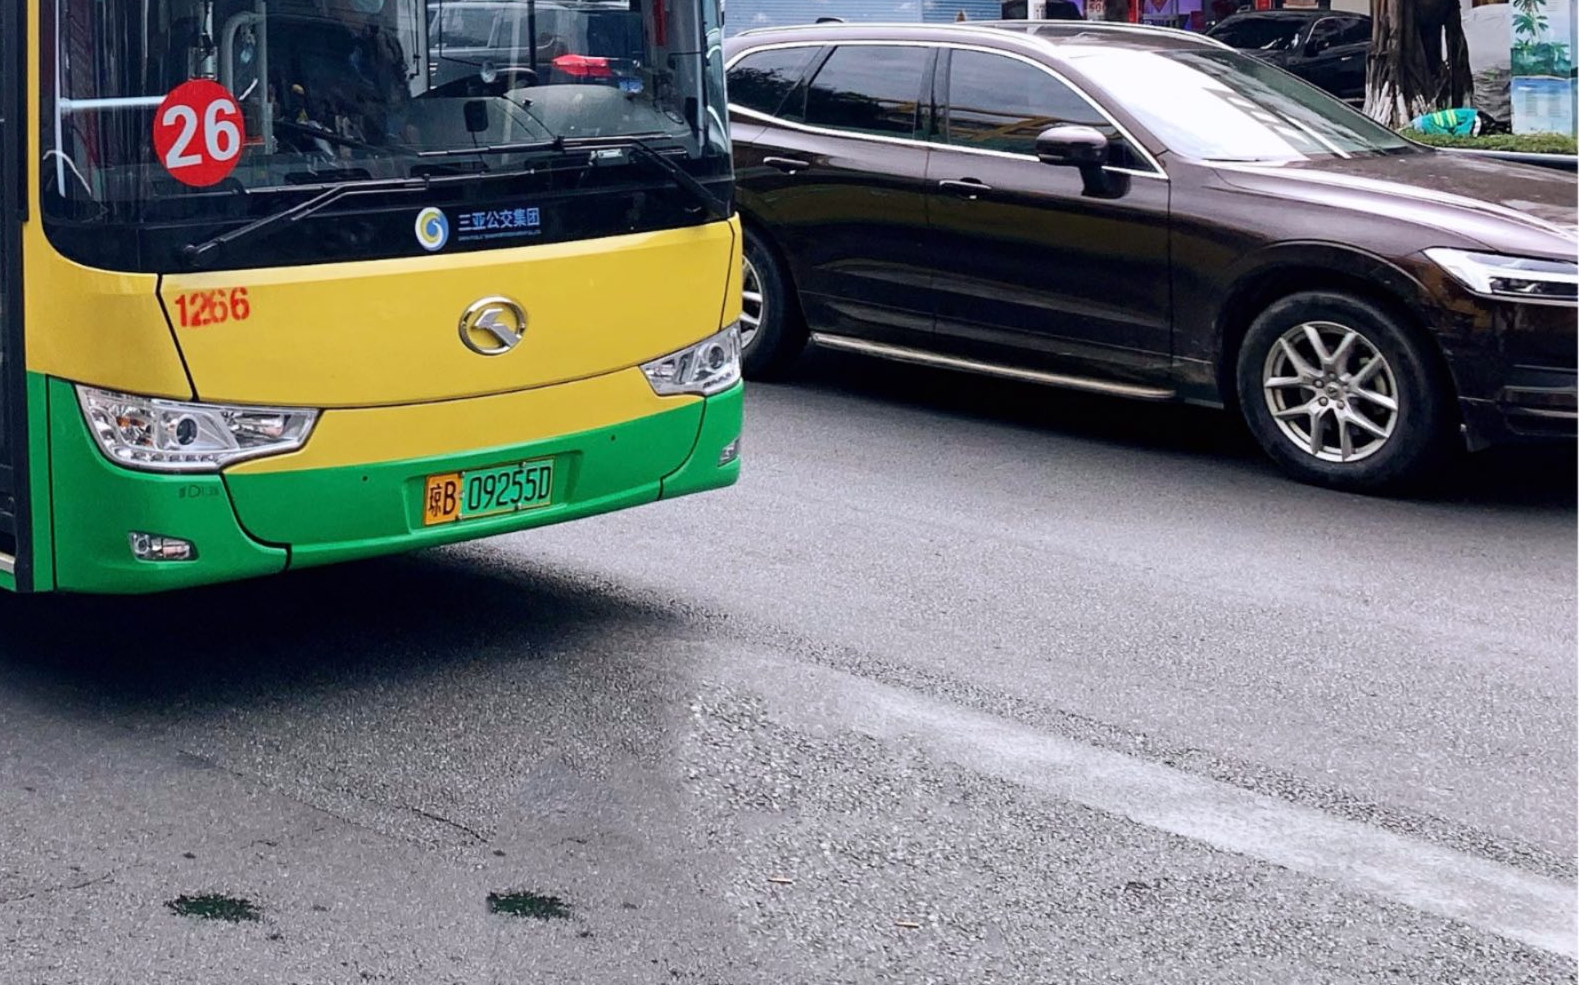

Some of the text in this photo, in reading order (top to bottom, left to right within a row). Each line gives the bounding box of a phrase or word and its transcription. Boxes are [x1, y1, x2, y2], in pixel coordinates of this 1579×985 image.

[162, 98, 241, 169] 26
[458, 207, 541, 232] 三亚公交集团
[174, 286, 251, 328] 1266
[468, 466, 552, 511] 09255D
